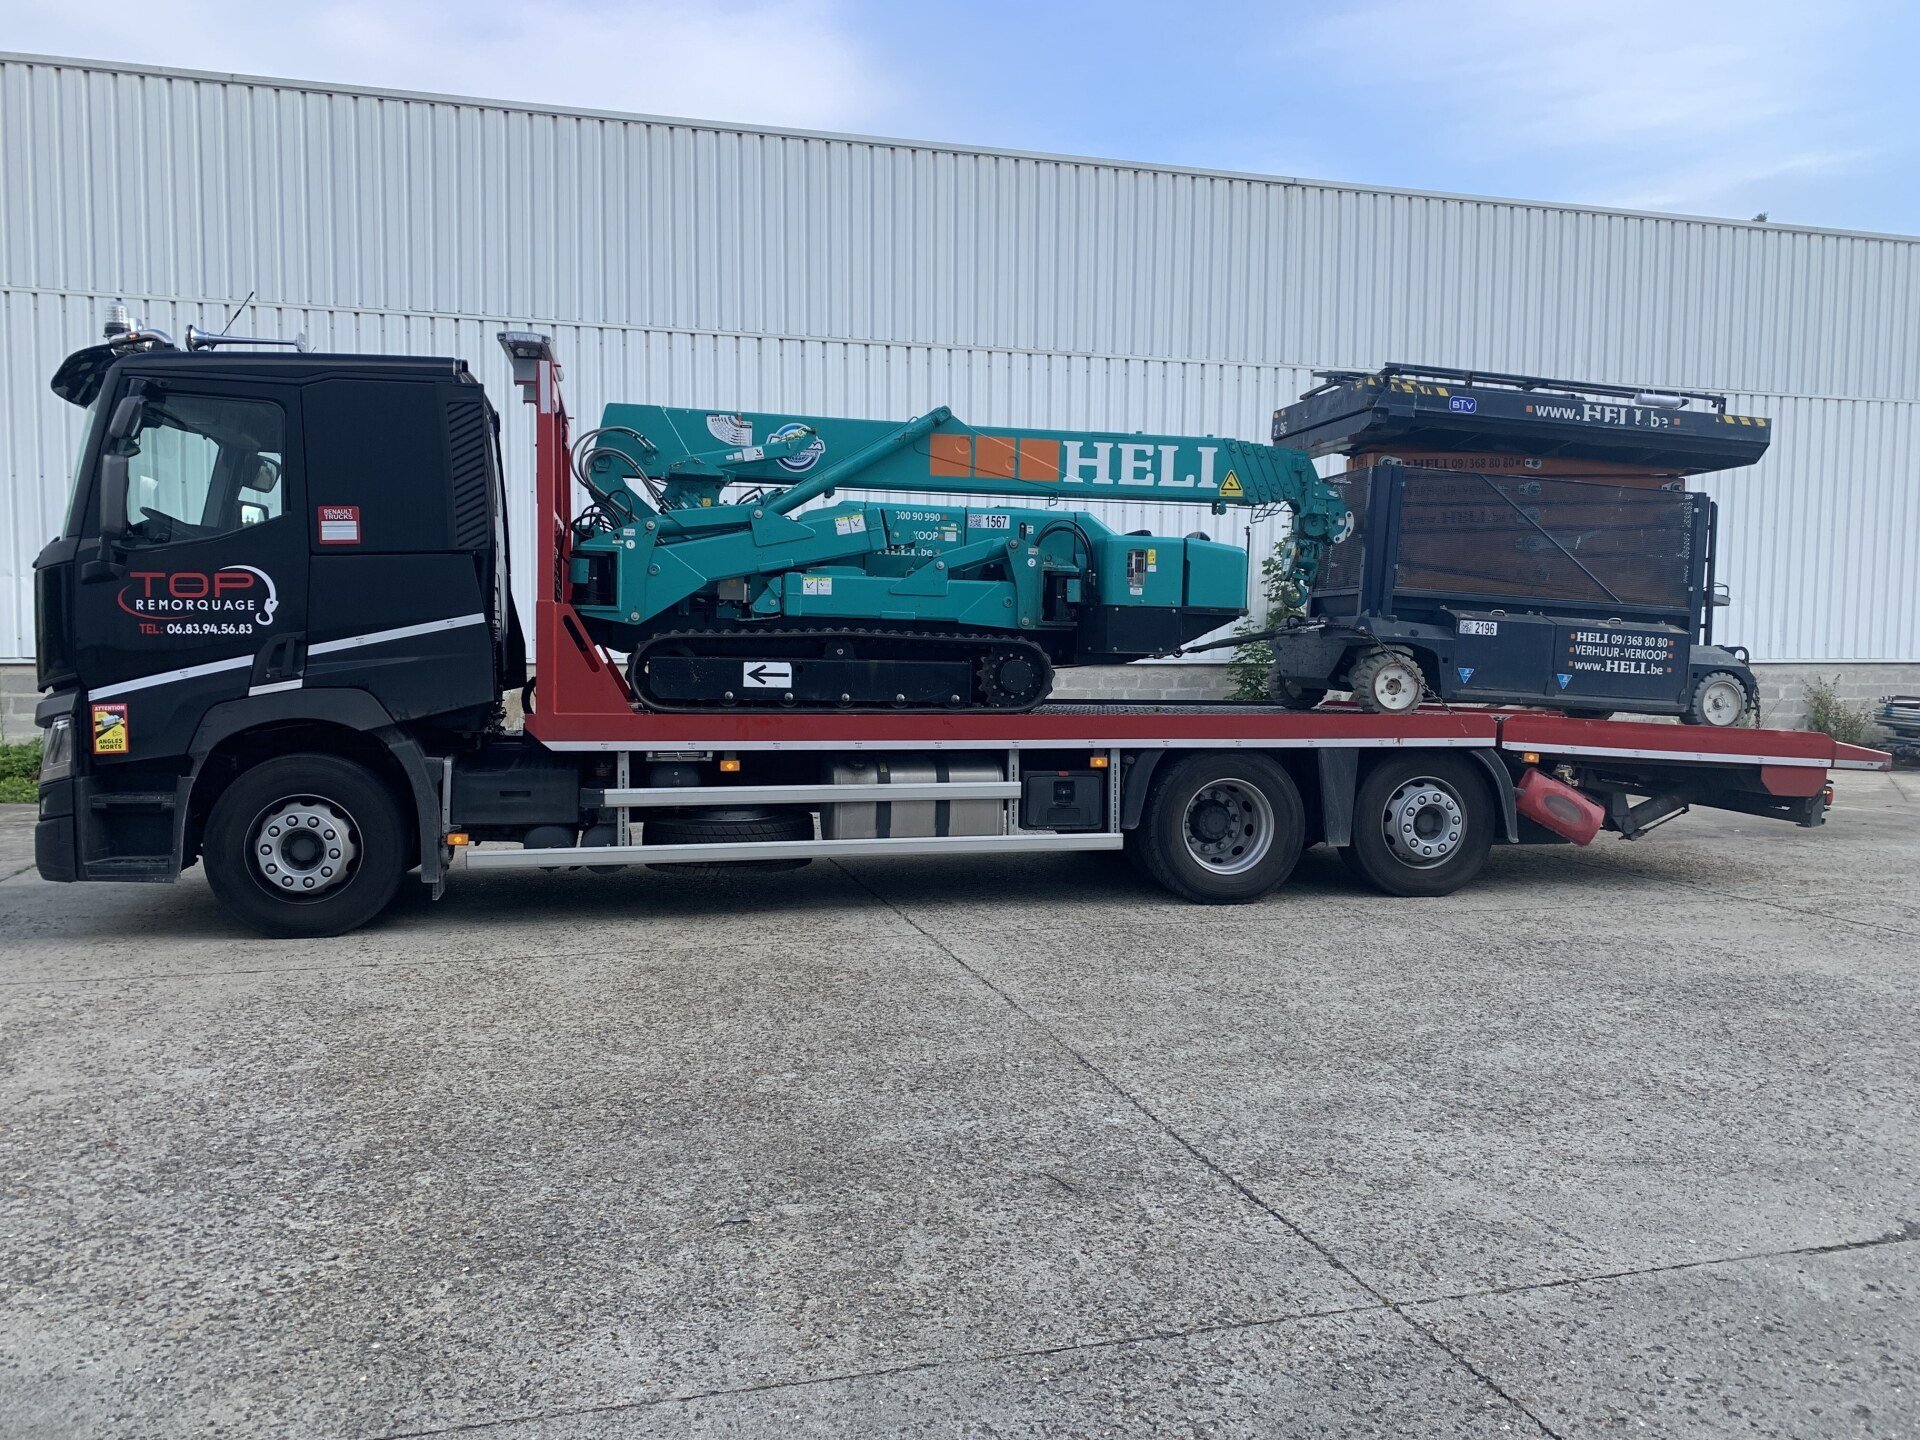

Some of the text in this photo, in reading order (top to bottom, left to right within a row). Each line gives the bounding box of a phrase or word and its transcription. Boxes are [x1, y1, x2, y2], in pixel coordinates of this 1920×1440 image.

[1452, 400, 1474, 410] BTV
[1063, 440, 1219, 488] HELI
[1489, 458, 1500, 468] 80
[1503, 457, 1515, 467] 80
[912, 512, 923, 521] 90
[924, 512, 941, 522] 990
[985, 515, 1007, 528] 1567
[129, 571, 254, 598] TOP
[135, 599, 255, 611] REMORQUAGE
[139, 623, 253, 635] TEL: 06.83.94.56.83
[1474, 622, 1495, 635] 2196
[1576, 631, 1668, 648] HELI 09/368 80 80
[1575, 645, 1667, 661] VERHUUR-VERKOOP
[1574, 660, 1663, 675] www.HELI.be
